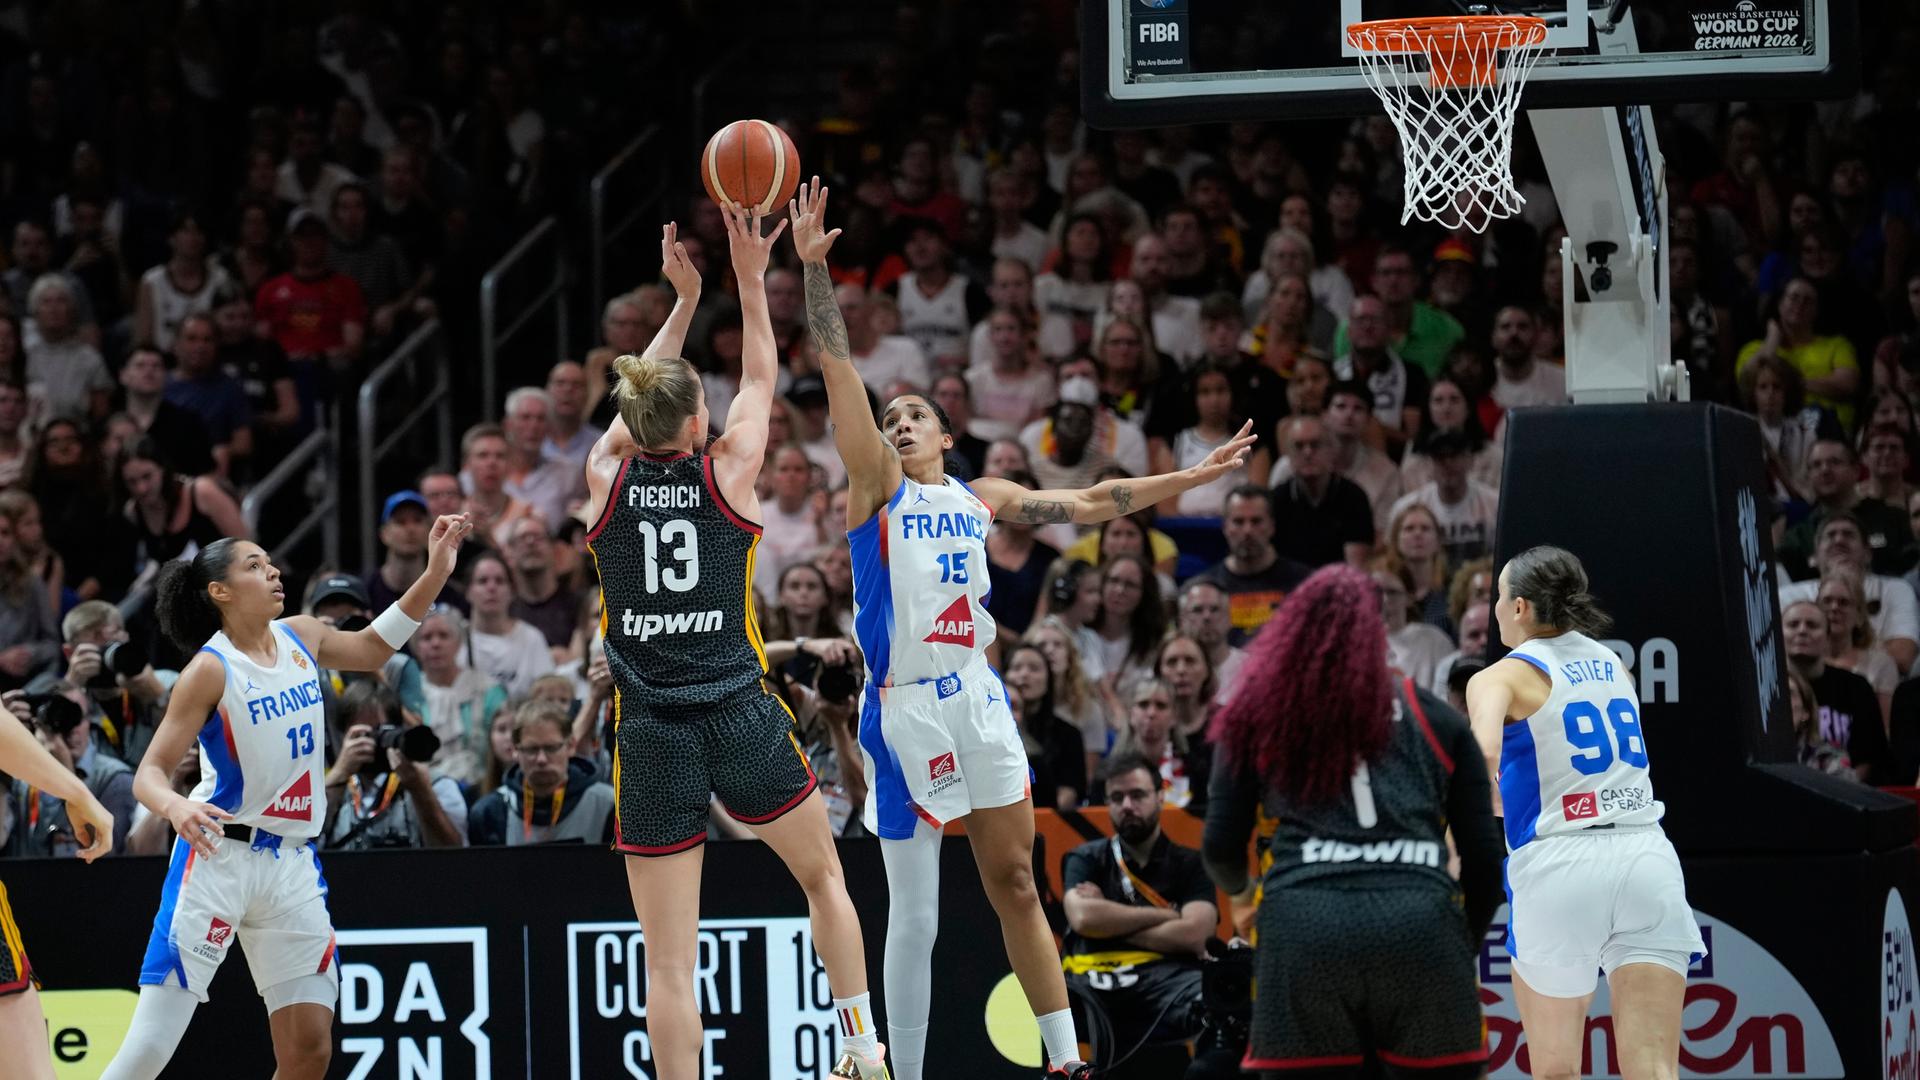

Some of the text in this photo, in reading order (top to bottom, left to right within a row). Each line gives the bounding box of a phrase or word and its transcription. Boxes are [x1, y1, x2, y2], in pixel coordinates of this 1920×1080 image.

[1692, 10, 1800, 20] WOMEN'S BASKETBALL
[1694, 18, 1799, 34] WORLD CUP
[1139, 22, 1180, 43] FIBA
[1695, 34, 1799, 50] GERMANY 2026
[1157, 58, 1184, 66] Basketball
[628, 485, 701, 508] FIEBICH
[638, 519, 700, 594] 13
[936, 551, 969, 584] 15
[622, 608, 723, 642] tipwin
[932, 620, 975, 637] MAIF
[1559, 660, 1615, 687] ASTIER
[286, 722, 315, 760] 13
[1562, 697, 1648, 776] 98
[273, 796, 312, 812] MAIF
[594, 930, 749, 1018] CORT
[340, 962, 447, 1025] DA
